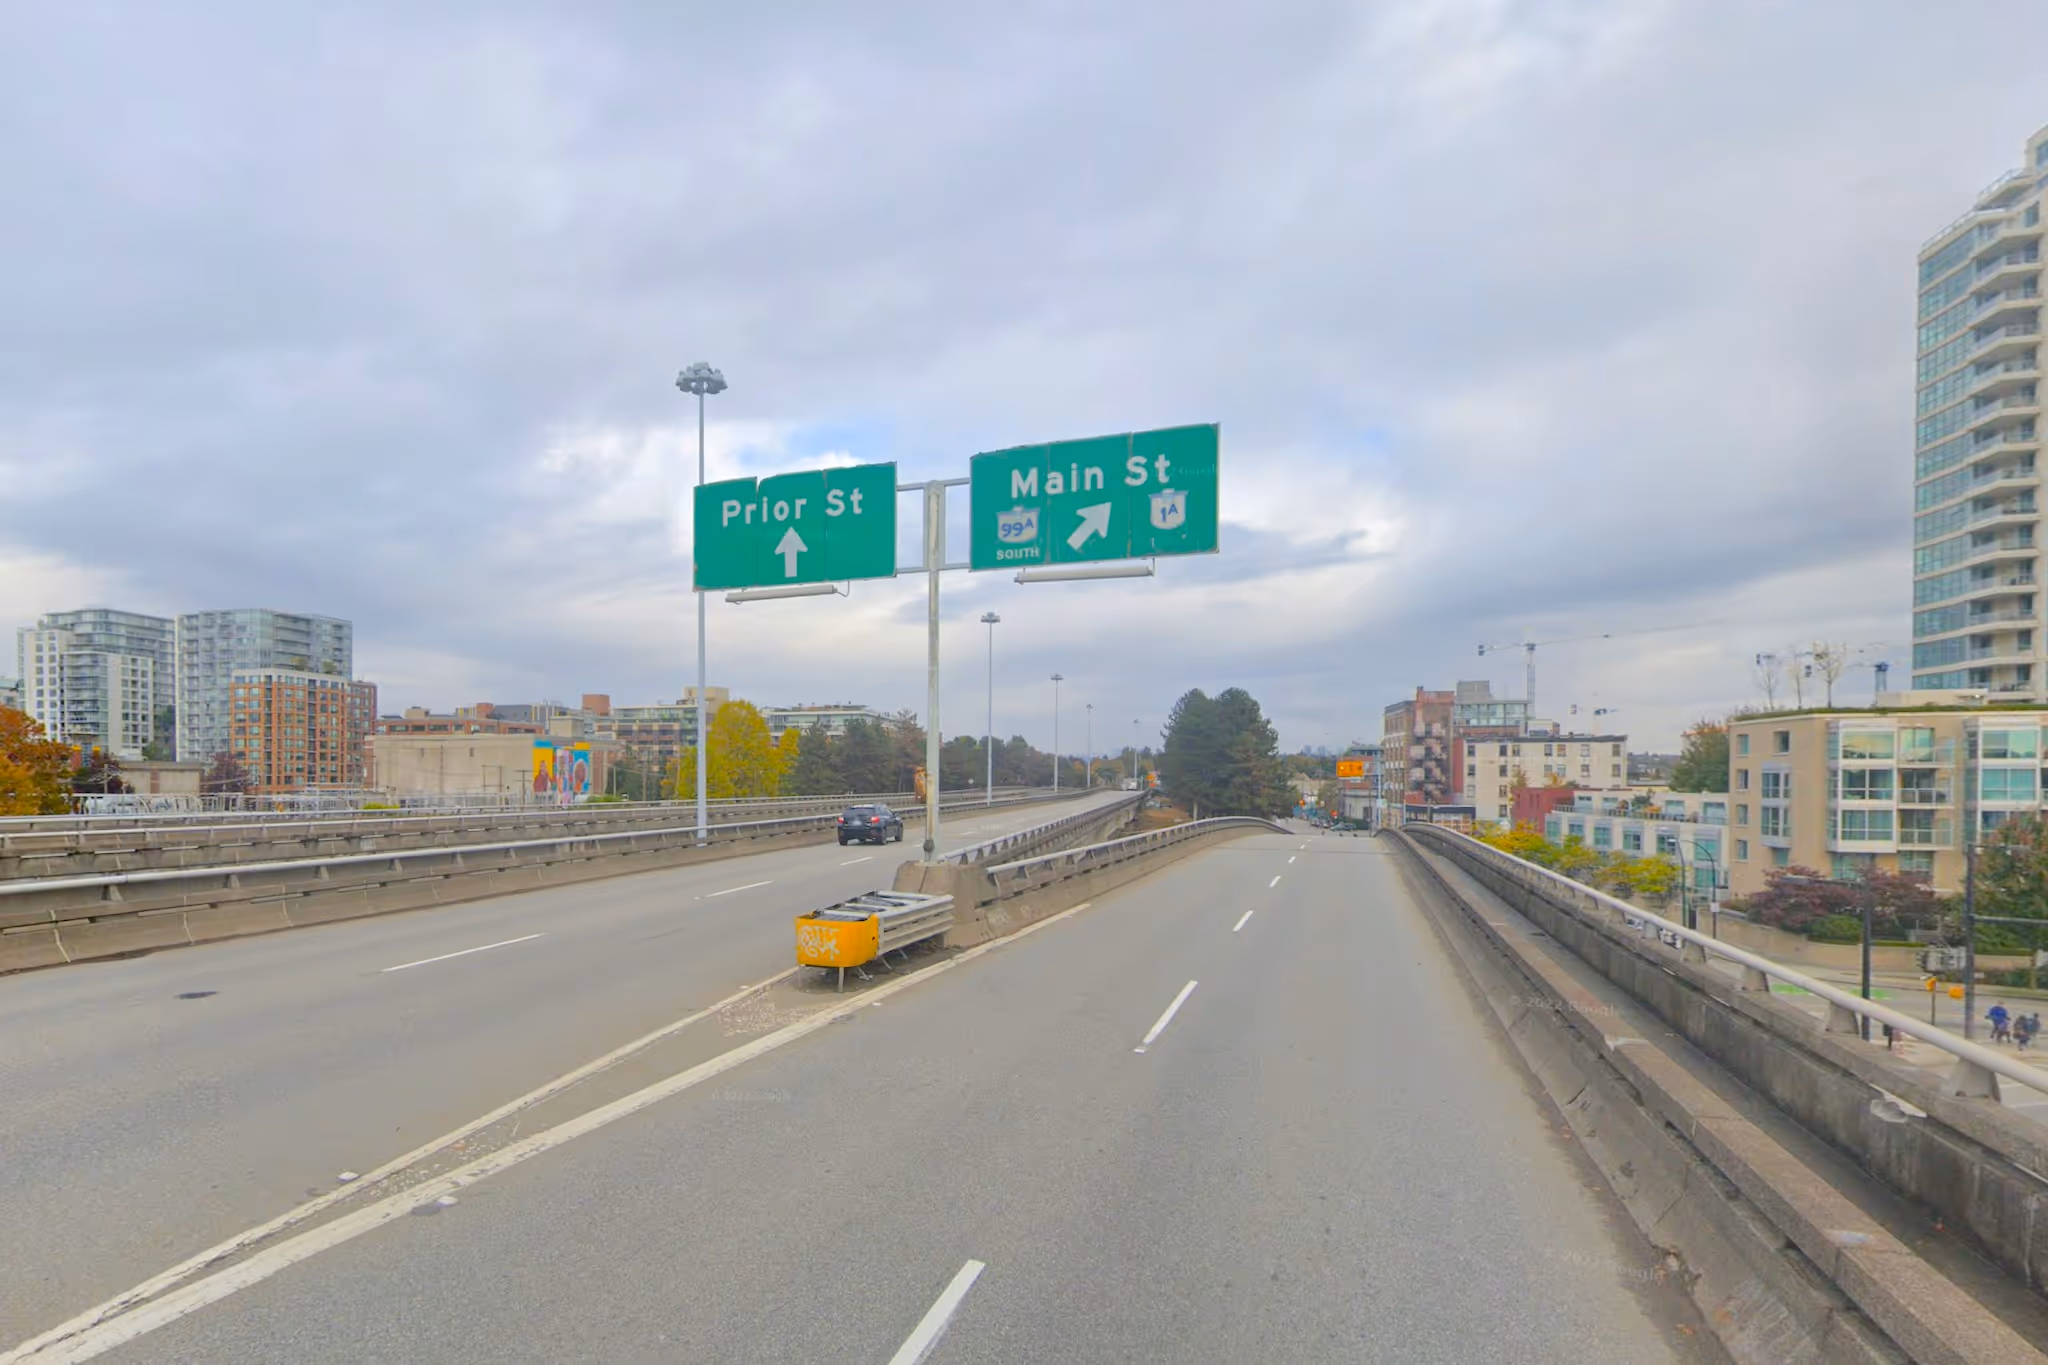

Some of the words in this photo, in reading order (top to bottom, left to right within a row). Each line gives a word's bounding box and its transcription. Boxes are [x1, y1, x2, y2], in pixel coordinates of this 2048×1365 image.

[1011, 462, 1104, 499] Main
[1124, 454, 1171, 486] St
[722, 496, 807, 527] Prior
[825, 487, 863, 517] St
[1160, 503, 1179, 523] 1A
[1000, 517, 1034, 539] 99A
[996, 547, 1040, 560] SOUTH
